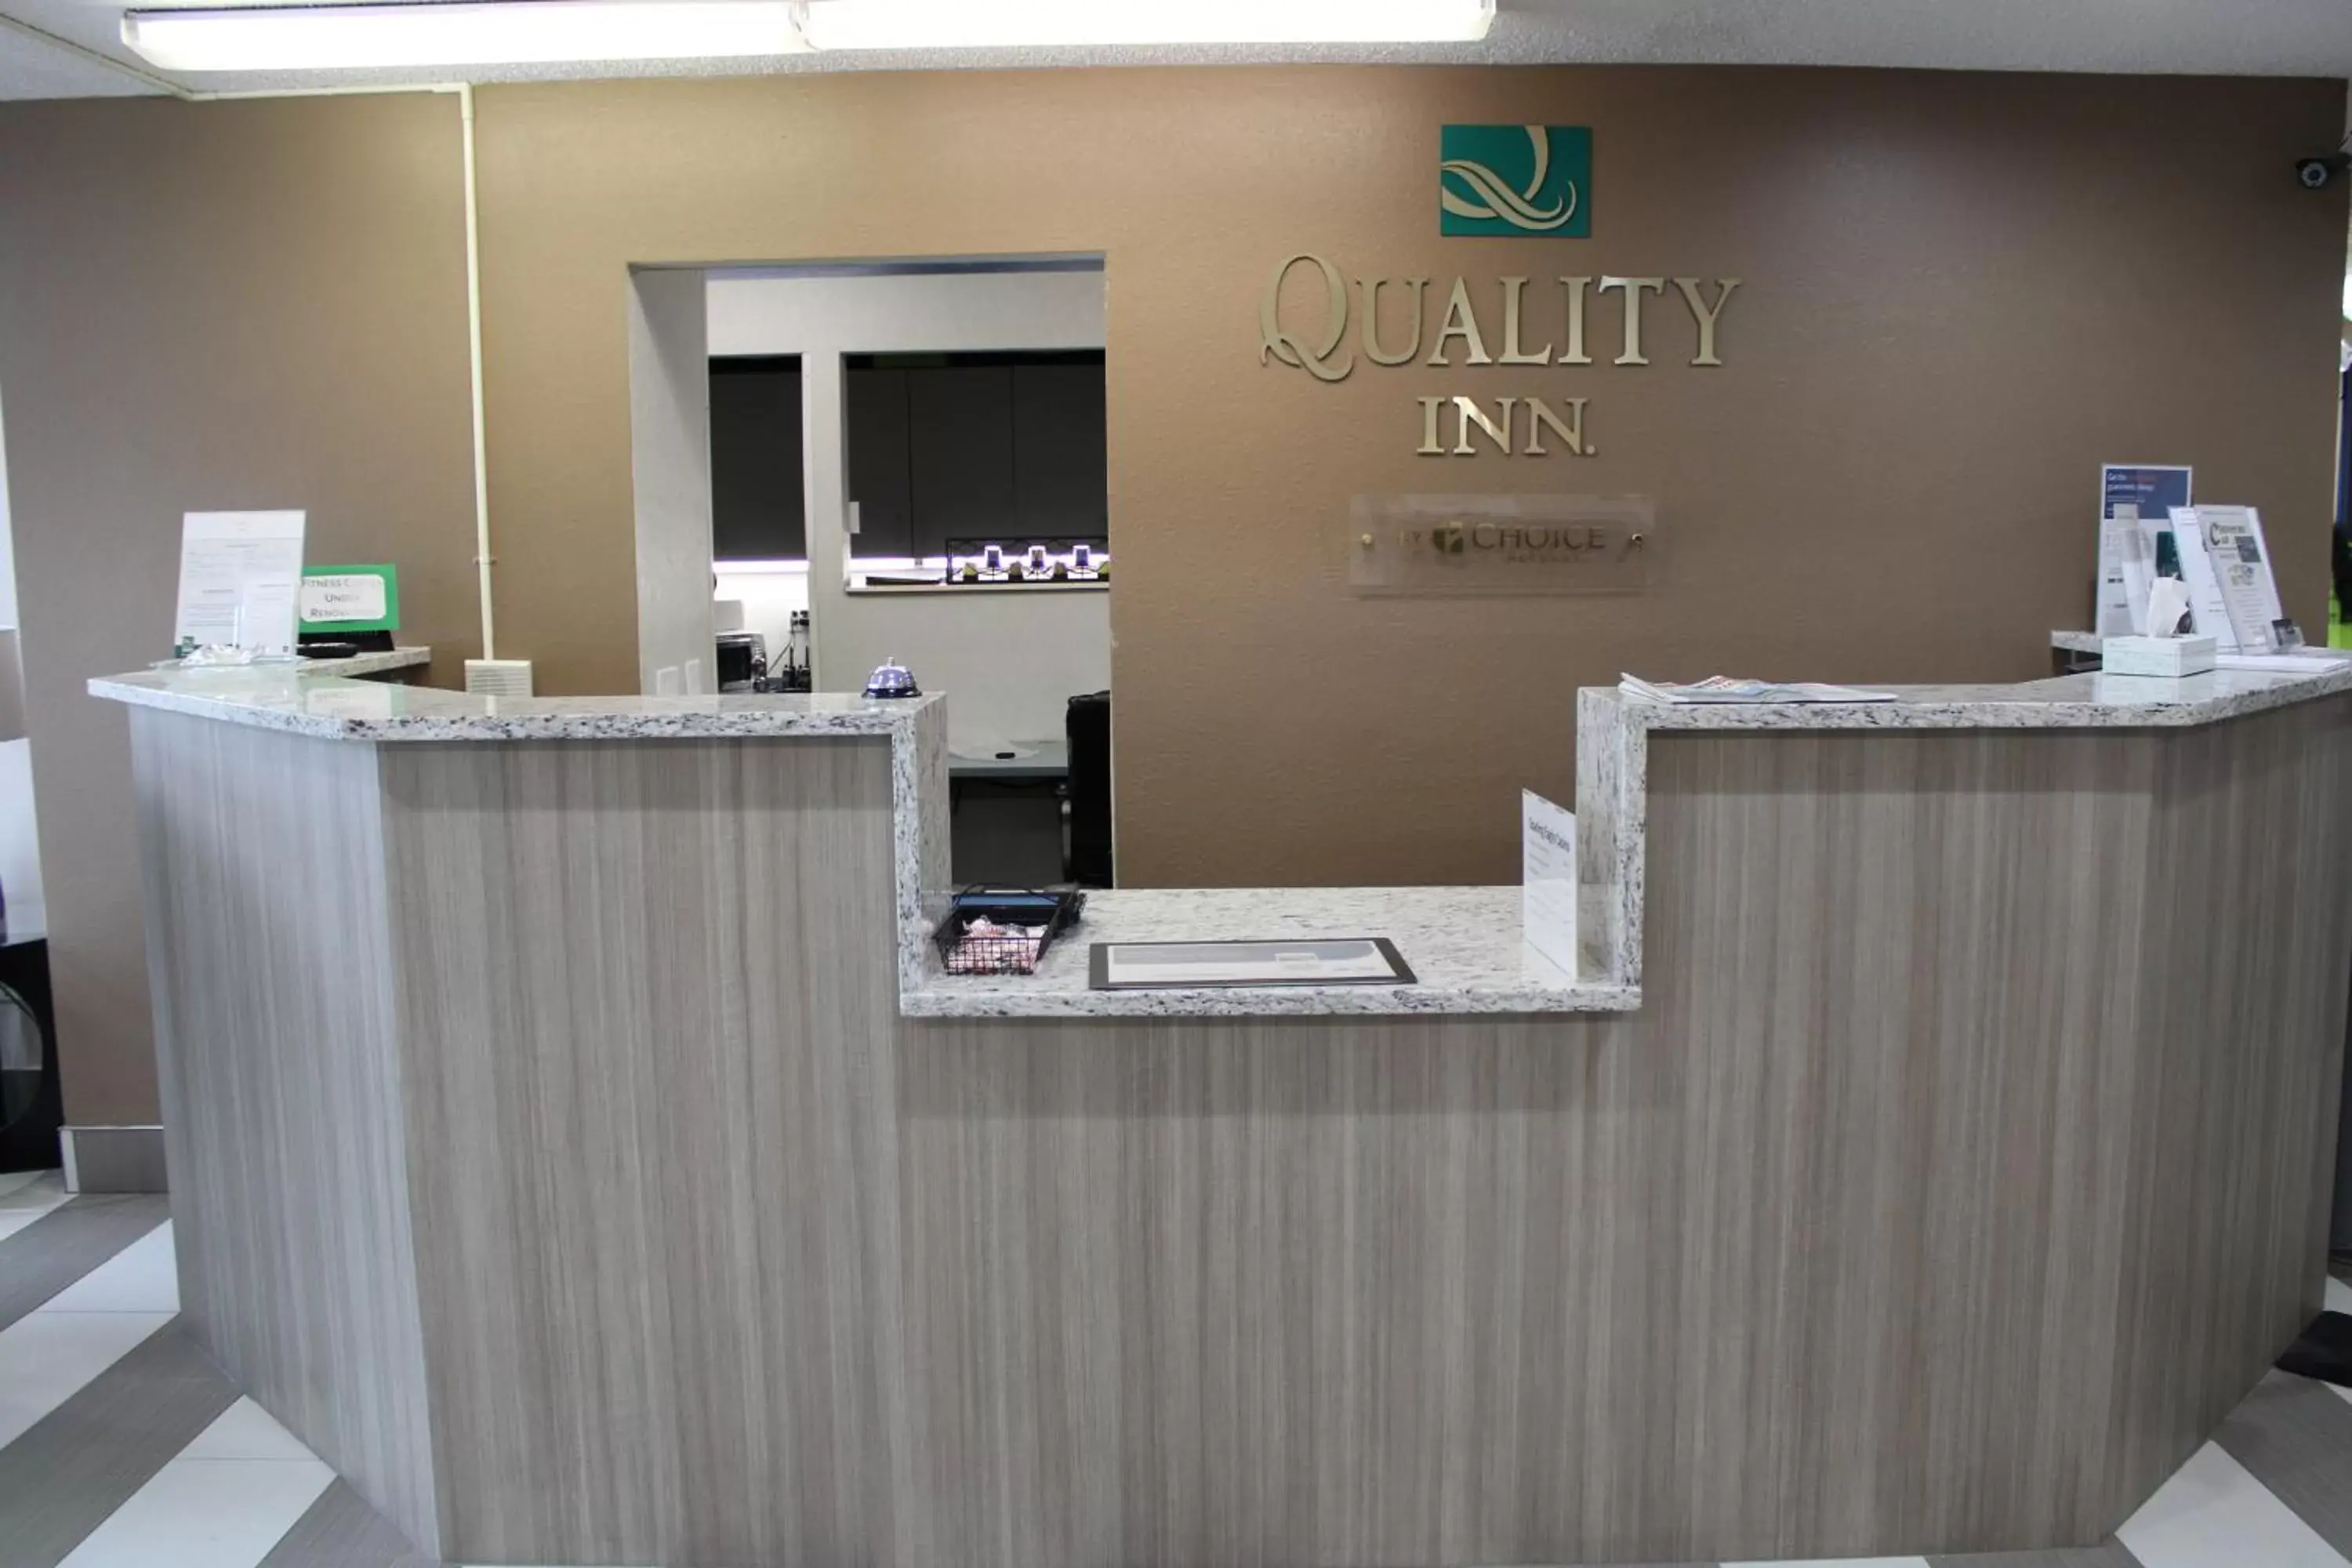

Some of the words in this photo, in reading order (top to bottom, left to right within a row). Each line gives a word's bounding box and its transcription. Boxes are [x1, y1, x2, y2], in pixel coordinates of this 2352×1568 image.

[1259, 252, 1741, 382] QUALITY
[1417, 396, 1598, 456] INN.
[1472, 523, 1607, 550] CHOICE
